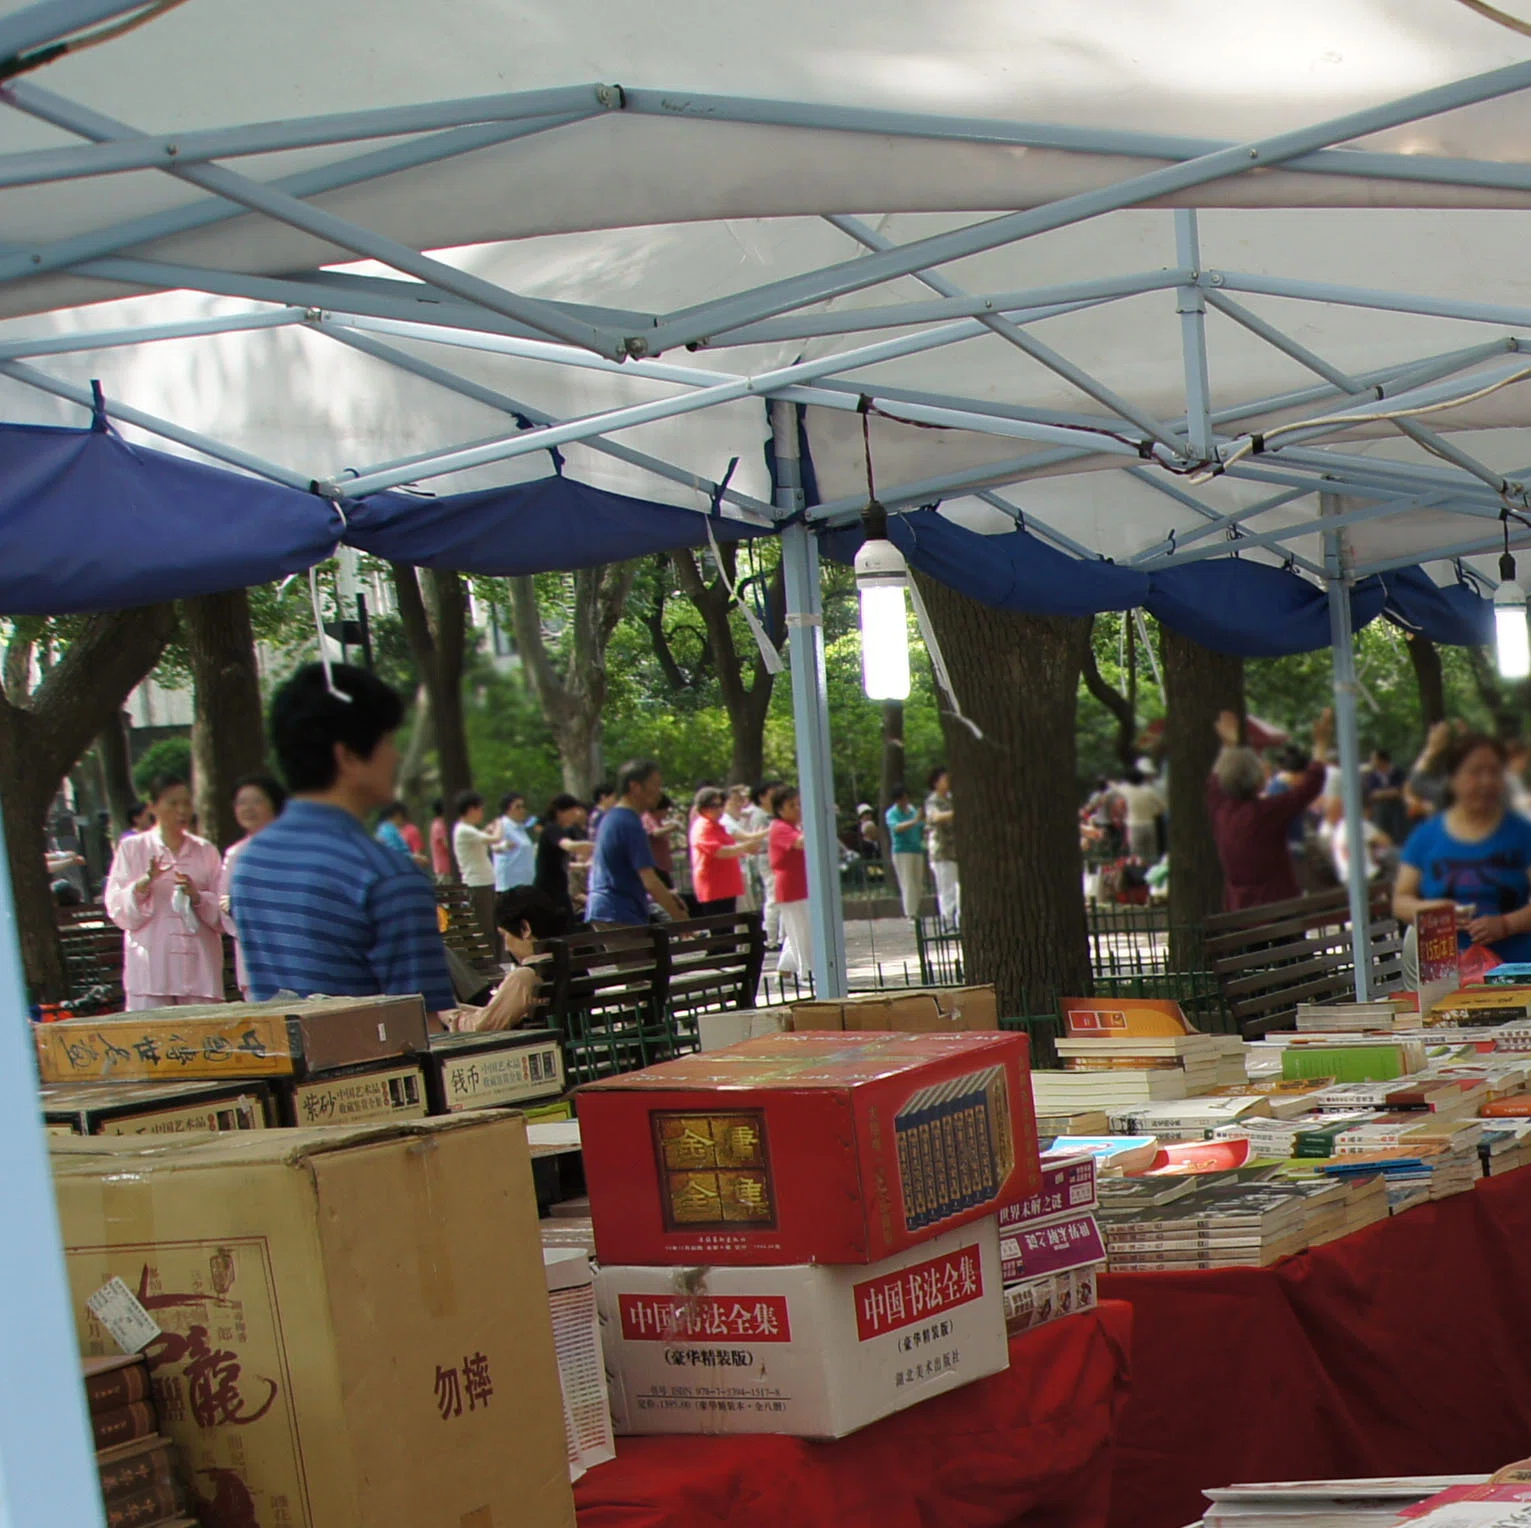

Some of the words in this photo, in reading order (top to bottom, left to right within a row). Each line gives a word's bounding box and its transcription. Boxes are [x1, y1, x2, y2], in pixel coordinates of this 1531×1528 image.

[629, 1301, 779, 1336] 中国书法全集
[862, 1259, 978, 1334] 中国书法全集
[431, 1352, 494, 1422] 勿摔
